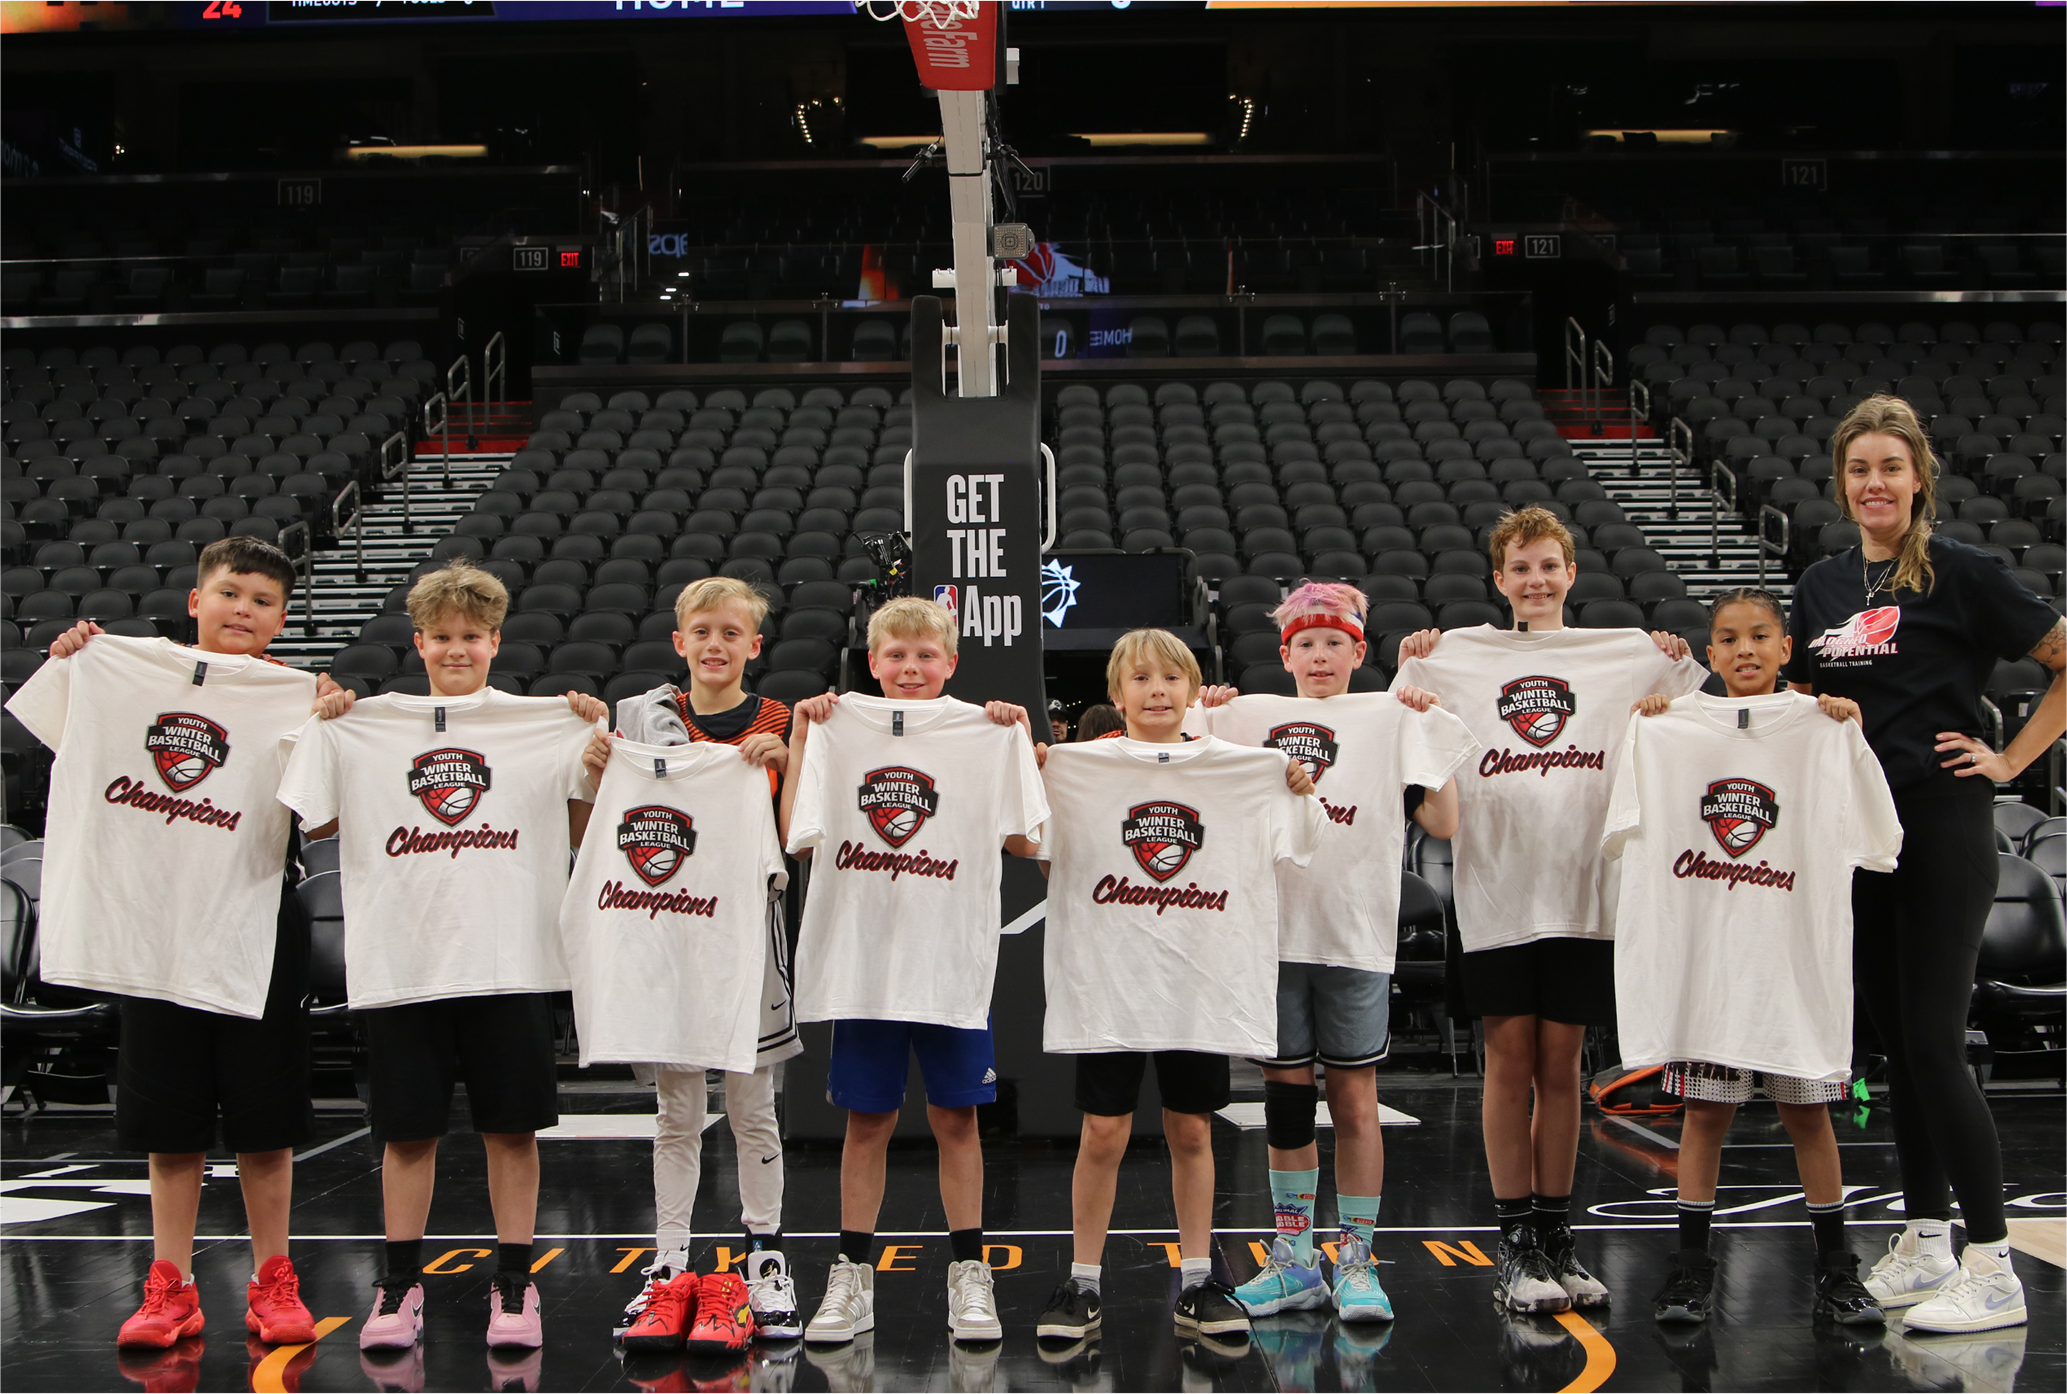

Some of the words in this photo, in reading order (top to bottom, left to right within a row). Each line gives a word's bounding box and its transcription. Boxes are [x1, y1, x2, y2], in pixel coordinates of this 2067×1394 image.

[1014, 171, 1044, 191] 120
[1791, 166, 1818, 185] 121
[286, 185, 314, 205] 119
[1495, 240, 1514, 255] EXIT
[1532, 239, 1554, 255] 121
[520, 251, 543, 267] 119
[560, 252, 580, 267] EXIT
[946, 473, 1004, 523] GET
[946, 528, 1006, 578] THE
[962, 585, 1022, 647] App
[1822, 642, 1898, 658] POTENTIAL
[1520, 680, 1548, 689] YOUTH
[1509, 689, 1557, 702] WINTER
[1501, 699, 1571, 717] BASKETBALL
[178, 717, 208, 730] YOUTH
[1288, 727, 1315, 735] YOUTH
[162, 726, 212, 745] WINTER
[1275, 736, 1321, 748] WINTER
[148, 735, 221, 763] BASKETBALL
[169, 746, 201, 758] LEAGUE
[432, 752, 463, 761] YOUTH
[1276, 746, 1331, 762] SKETBALL
[1479, 744, 1605, 777] Champions
[421, 762, 472, 776] WINTER
[884, 772, 914, 781] YOUTH
[411, 772, 486, 791] BASKETBALL
[433, 781, 466, 789] LEAGUE
[871, 782, 920, 796] WINTER
[1727, 783, 1755, 793] YOUTH
[104, 775, 242, 832] Champions
[860, 791, 932, 812] BASKETBALL
[882, 802, 912, 810] LEAGUE
[1714, 793, 1761, 807] WINTER
[643, 810, 672, 820] YOUTH
[1148, 806, 1178, 815] YOUTH
[1703, 802, 1773, 824] BASKETBALL
[1723, 813, 1752, 821] LEAGUE
[630, 821, 679, 834] WINTER
[1135, 816, 1185, 829] WINTER
[385, 822, 519, 859] Champions
[619, 831, 690, 850] BASKETBALL
[1125, 826, 1198, 845] BASKETBALL
[640, 841, 671, 849] LEAGUE
[835, 839, 959, 882] Champions
[1673, 849, 1796, 892] Champions
[597, 879, 718, 920] Champions
[1092, 874, 1229, 916] Champions
